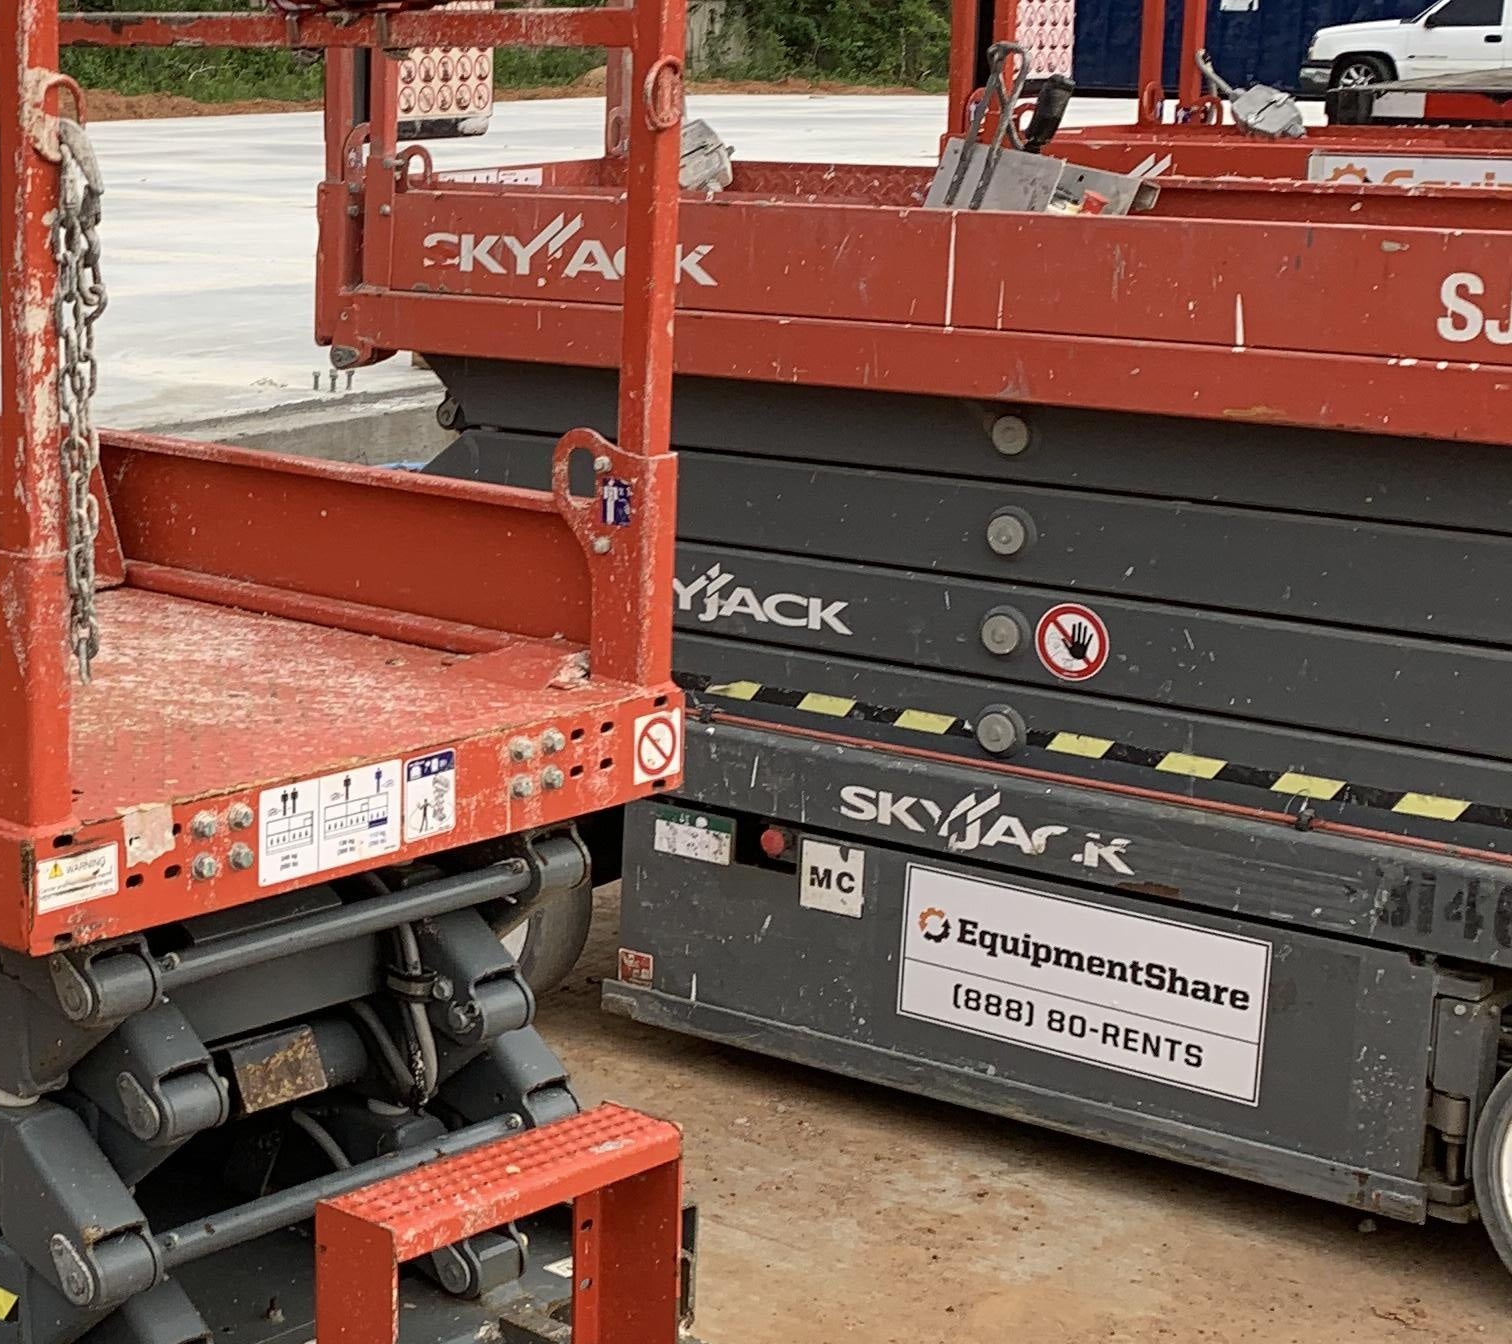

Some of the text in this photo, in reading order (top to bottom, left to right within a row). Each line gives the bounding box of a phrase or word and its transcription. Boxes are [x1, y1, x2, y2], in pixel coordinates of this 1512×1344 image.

[422, 212, 718, 286] SKYAK
[672, 561, 854, 636] YJACK
[808, 865, 855, 894] MC
[956, 918, 1250, 1012] EquipmentShare
[951, 981, 1204, 1069] (888) 80-RENTS
